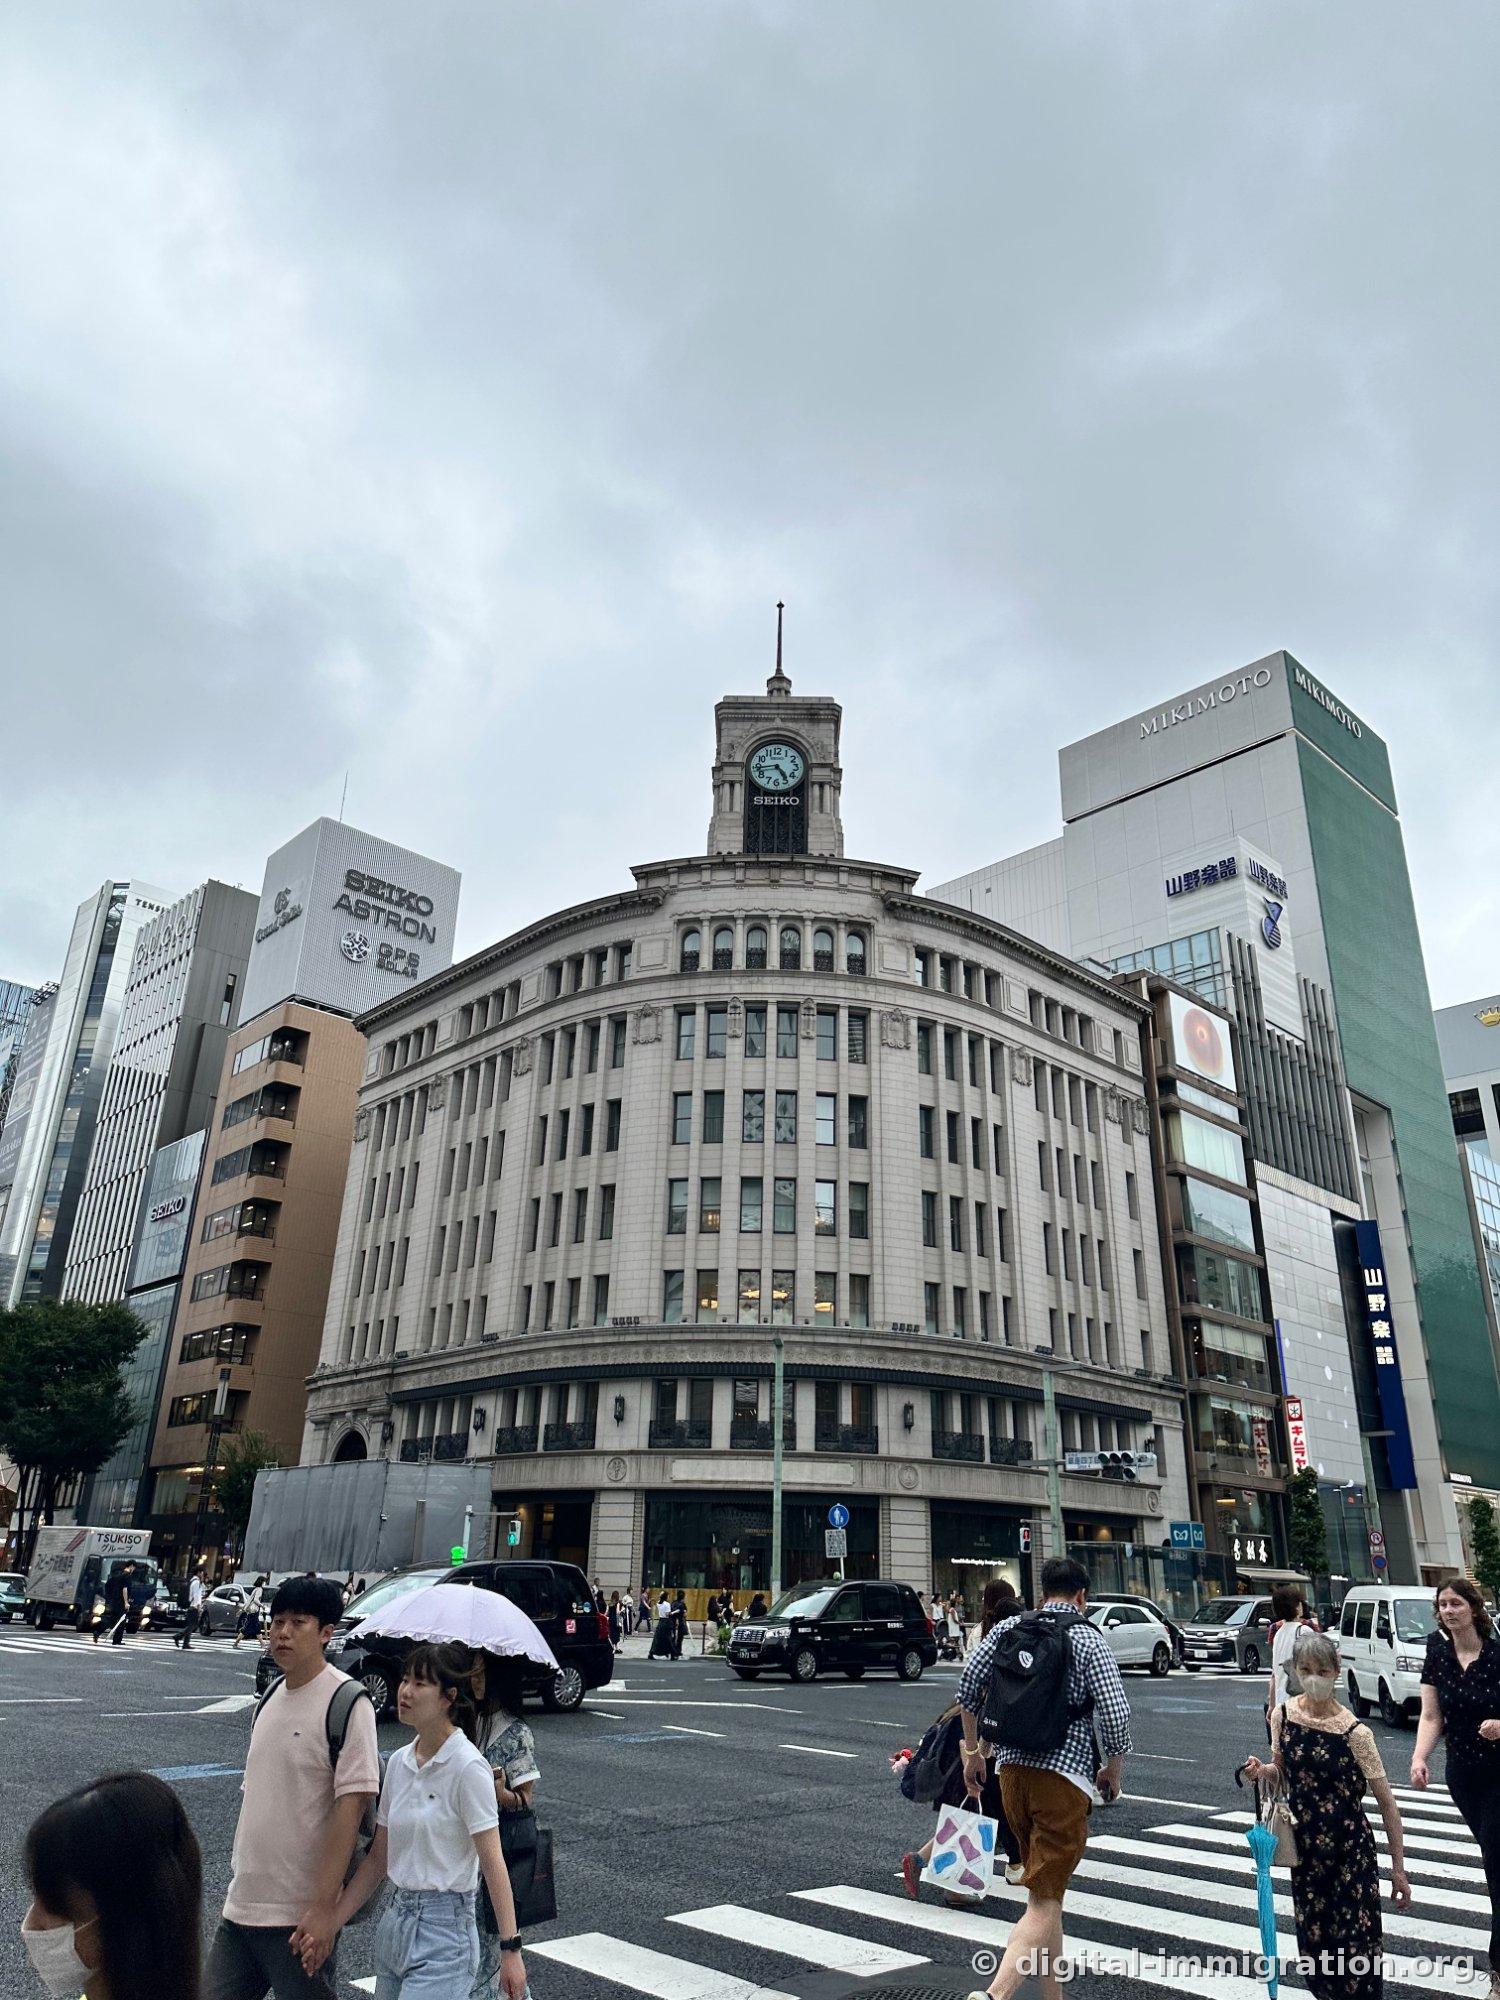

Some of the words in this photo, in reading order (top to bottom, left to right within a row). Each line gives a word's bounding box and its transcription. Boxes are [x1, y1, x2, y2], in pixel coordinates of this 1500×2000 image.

[1139, 668, 1272, 740] MIKIMOTO
[1294, 668, 1362, 739] MIKIMOTO
[753, 797, 800, 806] SEIKO
[344, 868, 434, 917] SEIKO
[1166, 857, 1238, 898] 山野楽器
[1249, 858, 1289, 900] 山野楽器
[332, 893, 437, 944] ASTRON
[376, 959, 419, 981] SOLAR
[378, 942, 421, 968] GPS
[150, 1195, 184, 1222] SEIKO
[1364, 1268, 1395, 1365] 山野楽器
[97, 1533, 142, 1545] TSUKISO
